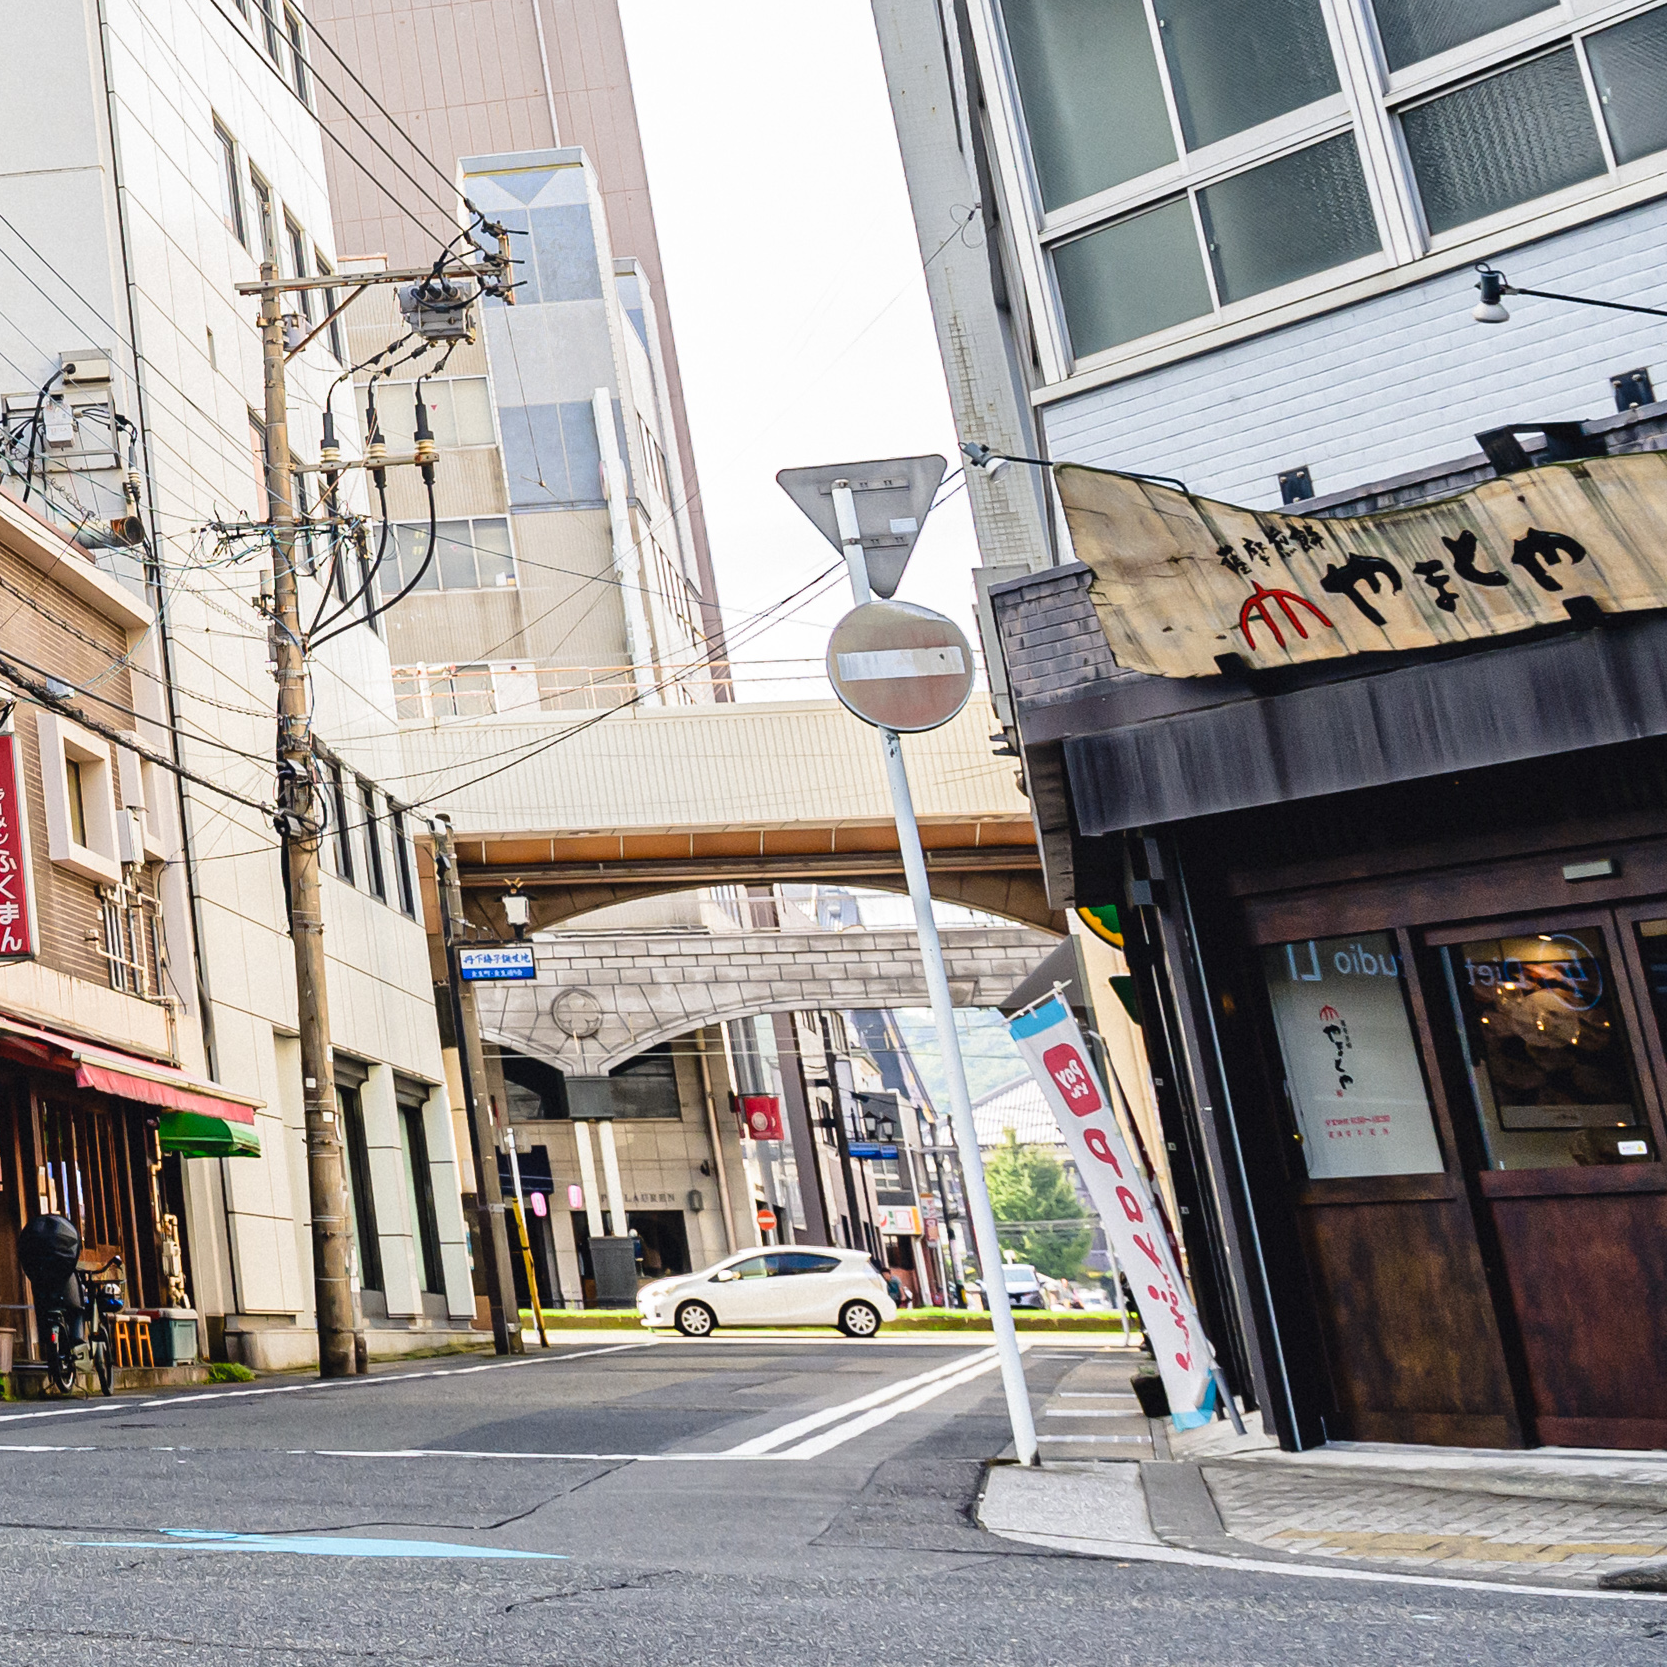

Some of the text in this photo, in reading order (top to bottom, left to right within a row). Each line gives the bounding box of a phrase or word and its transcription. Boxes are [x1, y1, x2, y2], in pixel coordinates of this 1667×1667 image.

[1320, 527, 1586, 626] やまとや
[624, 1194, 675, 1202] LAUREN
